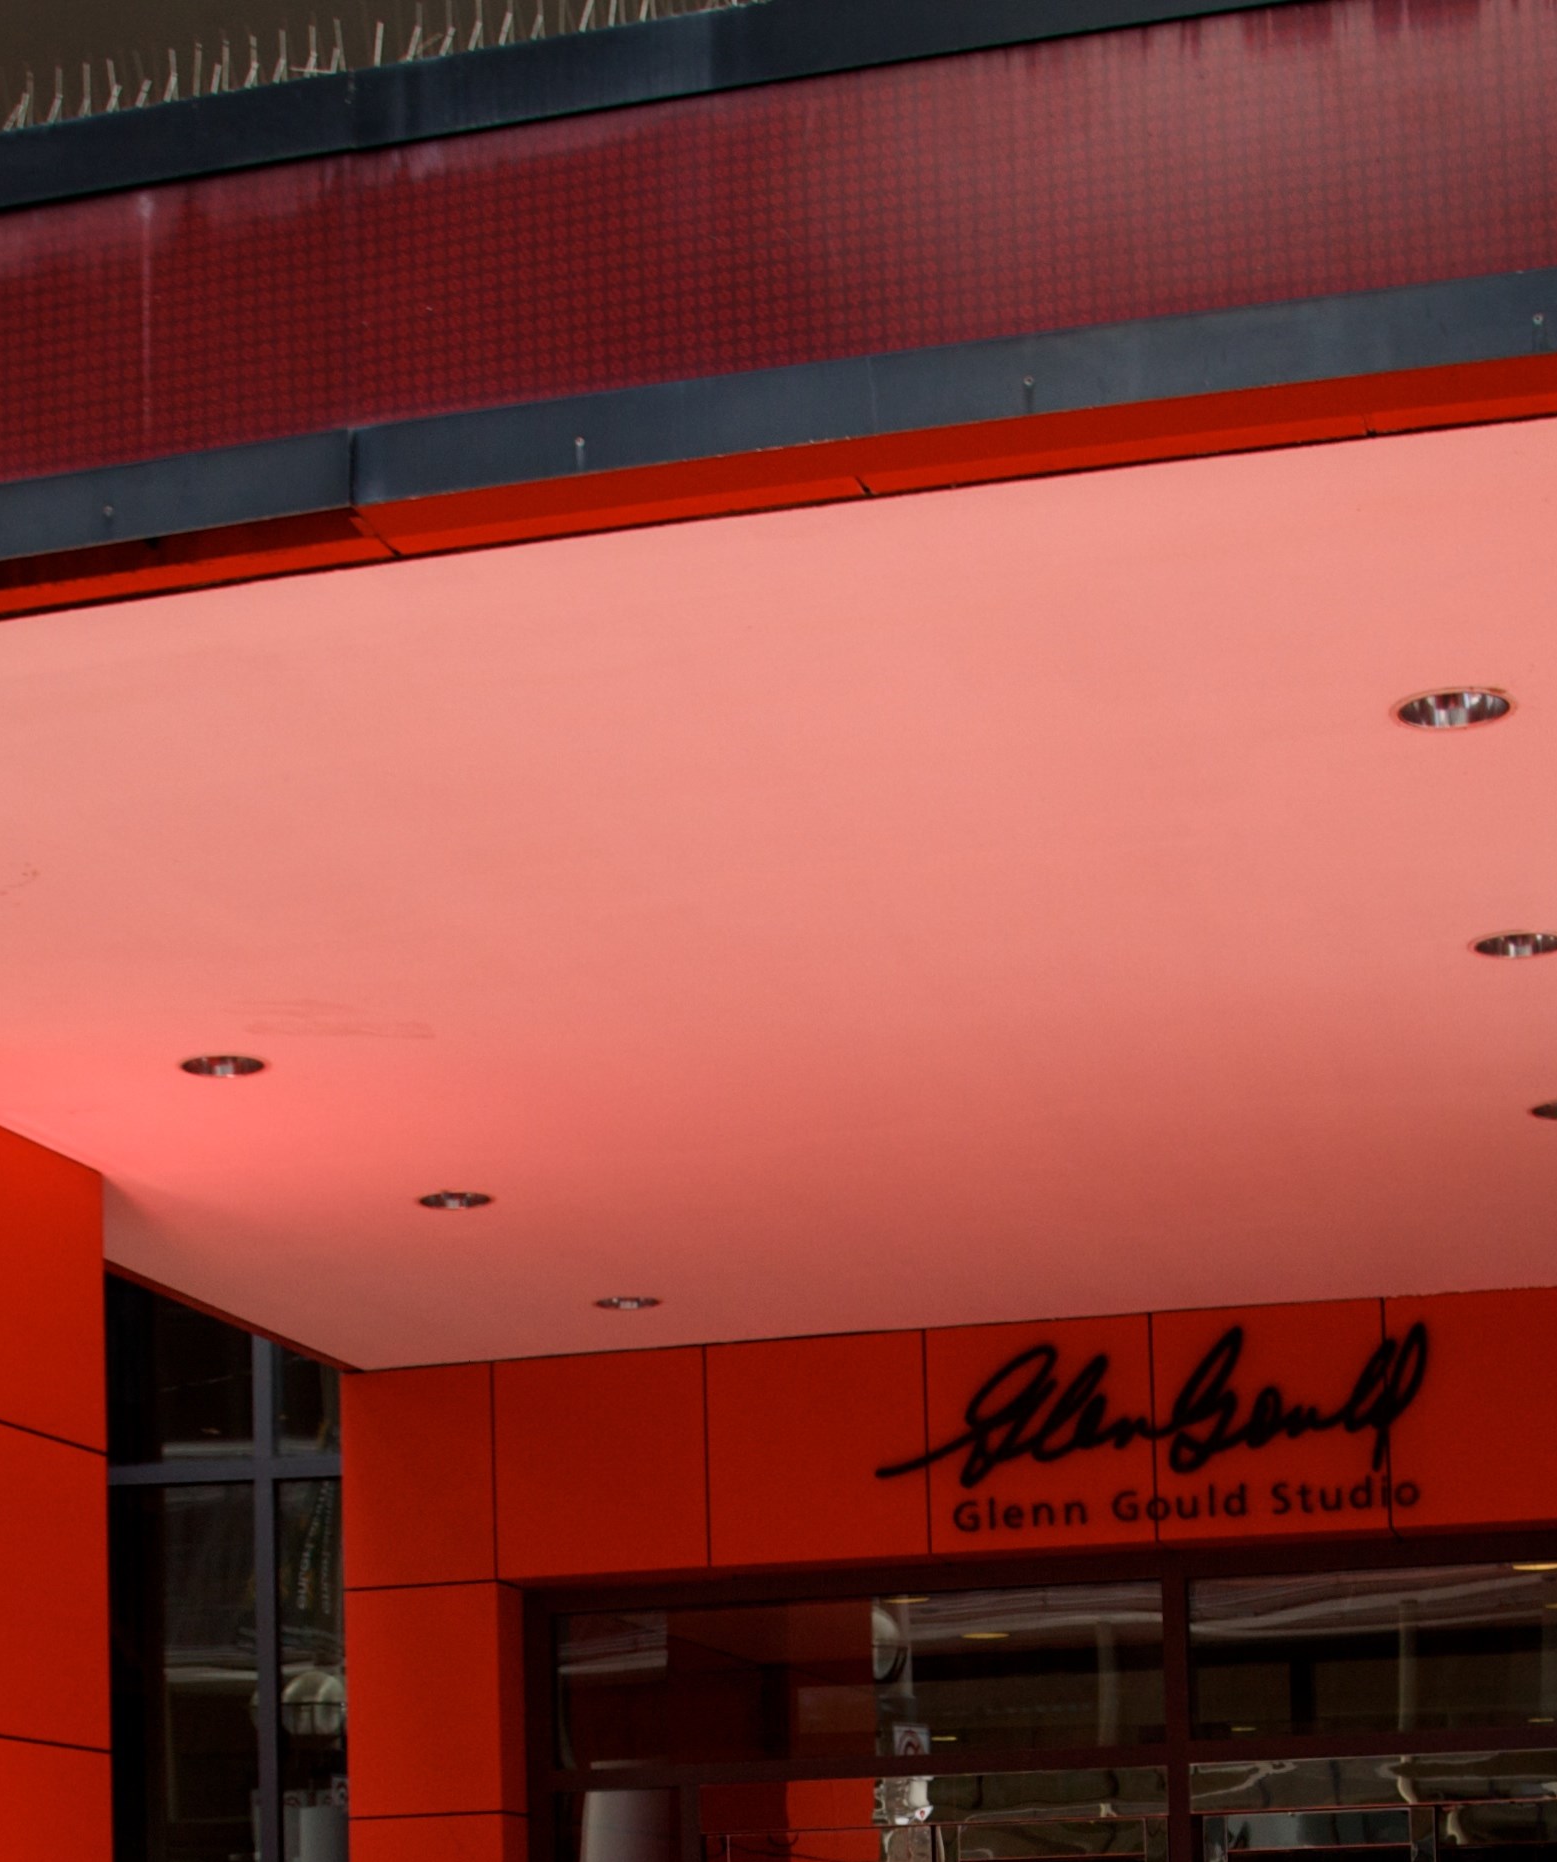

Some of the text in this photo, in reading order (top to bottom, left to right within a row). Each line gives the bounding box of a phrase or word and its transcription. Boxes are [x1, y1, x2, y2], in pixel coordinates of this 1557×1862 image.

[952, 1474, 1422, 1533] Glenn Gould Studio
